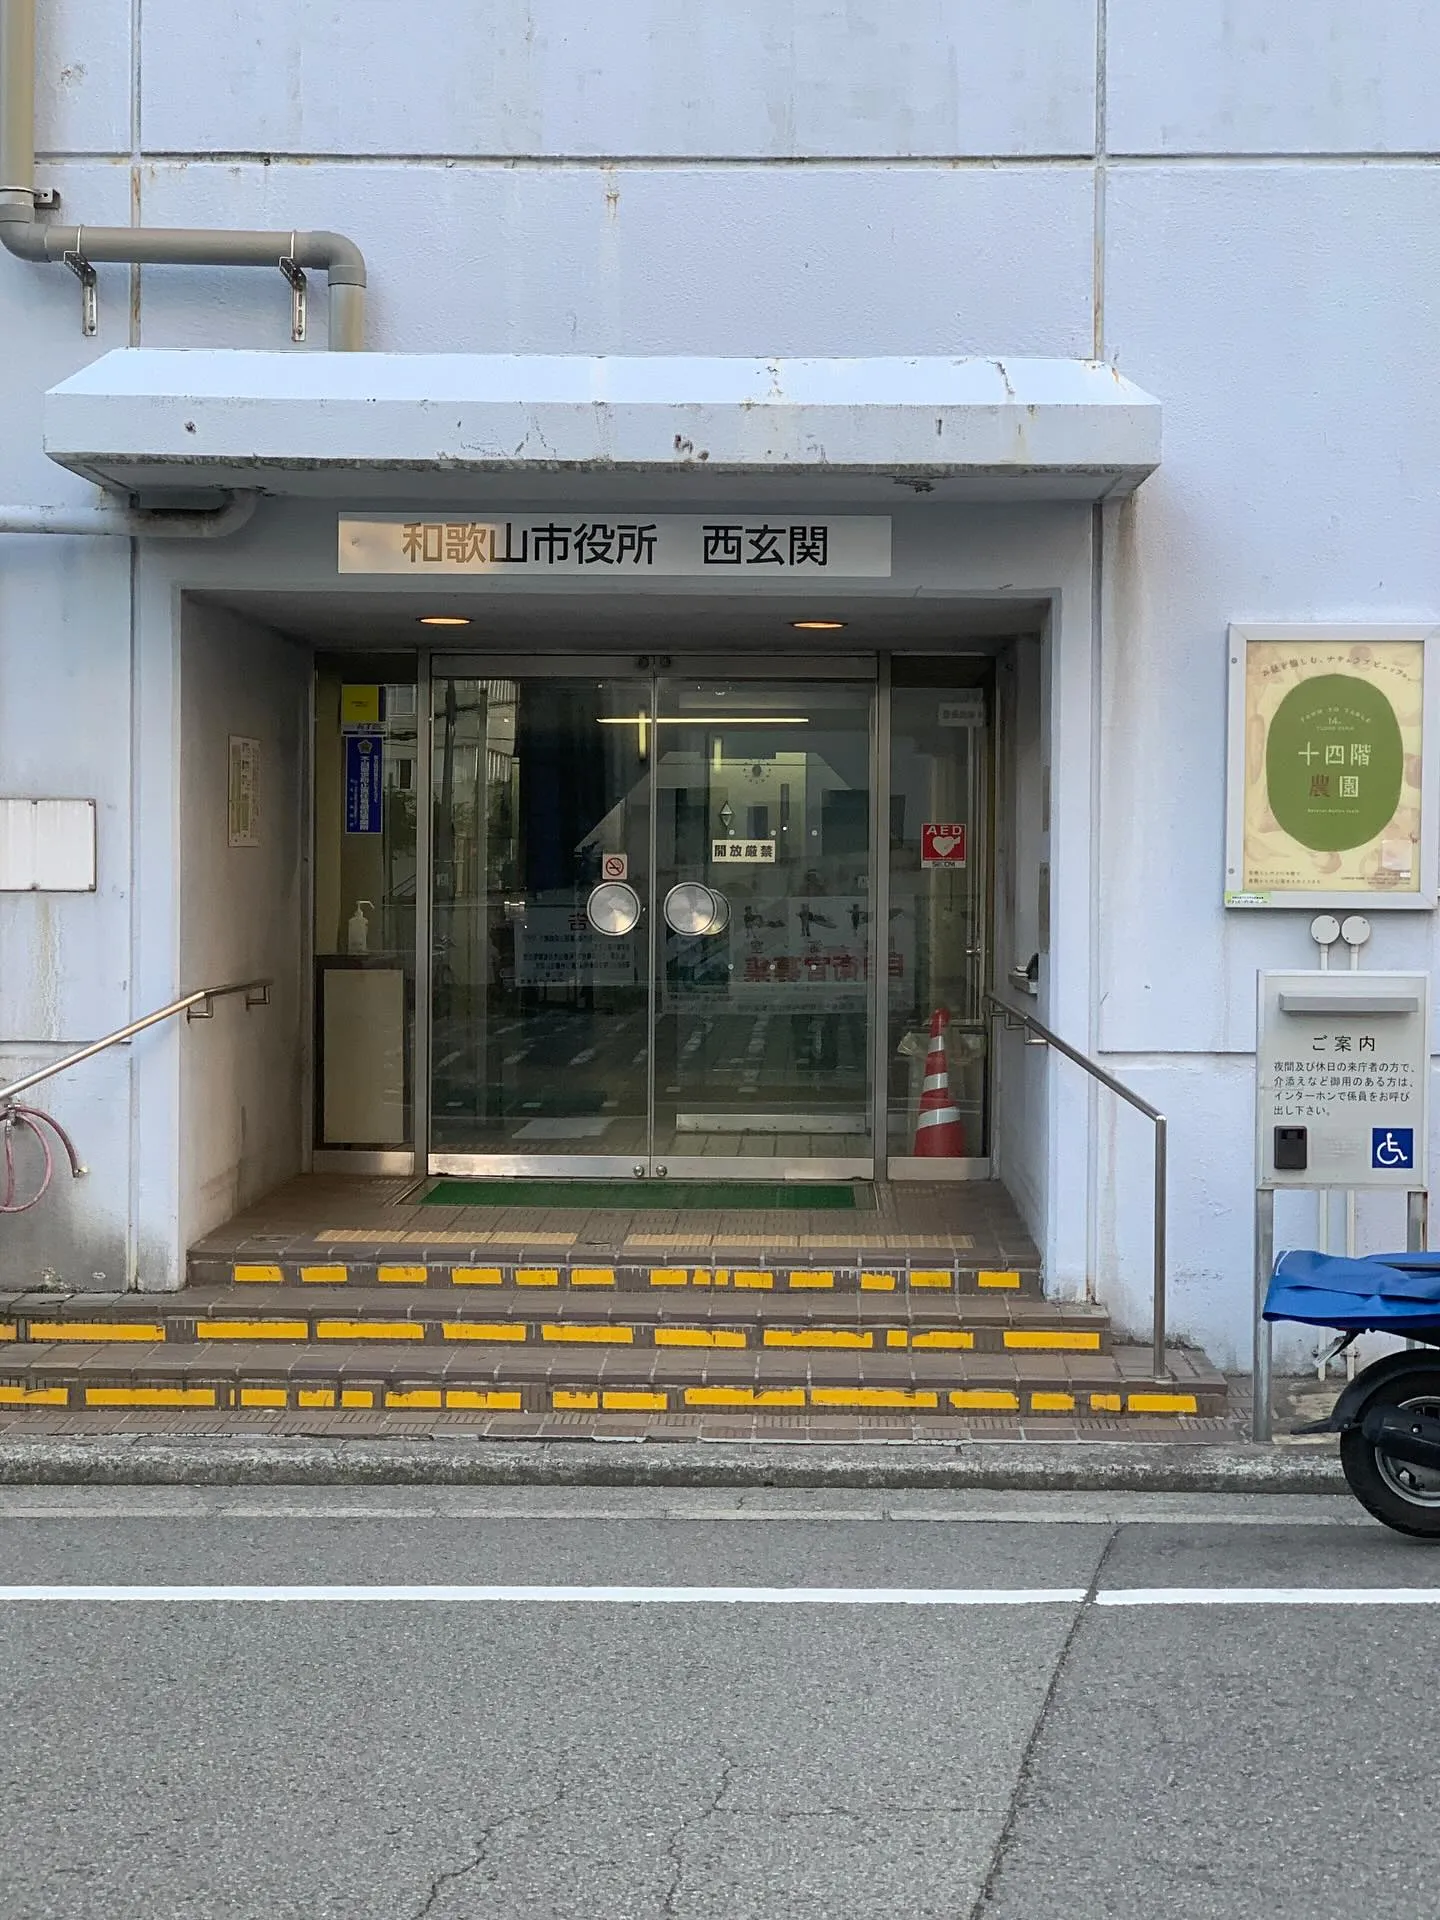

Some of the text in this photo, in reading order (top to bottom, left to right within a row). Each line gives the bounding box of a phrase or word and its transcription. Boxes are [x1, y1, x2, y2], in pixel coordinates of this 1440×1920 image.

[401, 522, 829, 566] 和歌山市役所 西玄関
[1298, 741, 1372, 766] 十四階
[1310, 774, 1359, 798] 農園
[926, 825, 962, 835] AED
[713, 844, 775, 858] 開放厳禁
[1312, 1035, 1375, 1052] ご案内
[1273, 1076, 1414, 1087] 介添えなど御用のある方は、
[1273, 1091, 1410, 1102] インターホンで係員をお呼び
[1273, 1105, 1331, 1116] 出し下さい。
